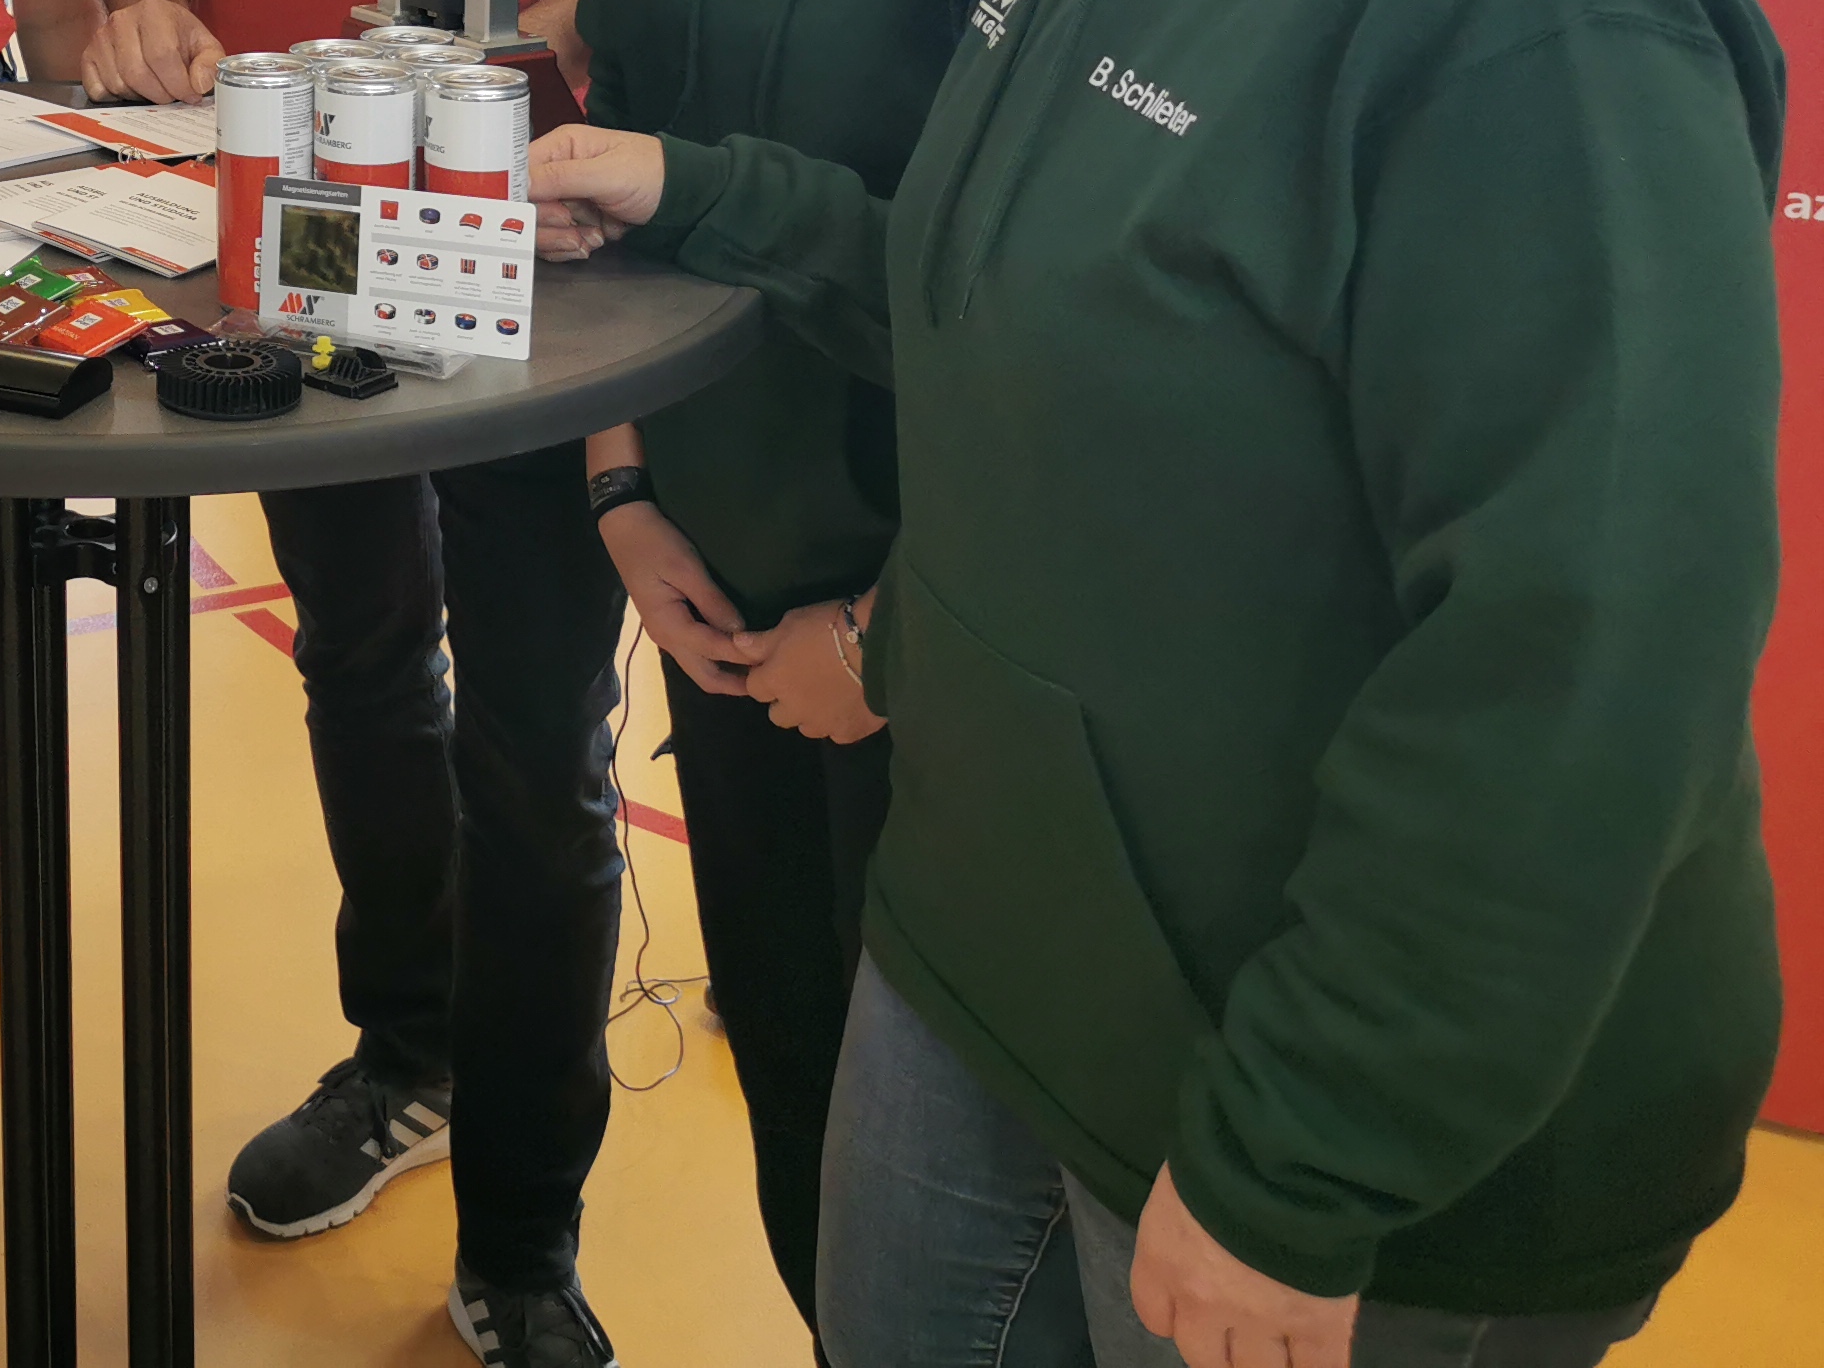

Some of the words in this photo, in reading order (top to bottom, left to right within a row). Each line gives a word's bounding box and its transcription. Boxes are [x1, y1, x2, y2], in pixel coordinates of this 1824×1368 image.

[1088, 56, 1115, 92] B.
[1111, 68, 1198, 136] Schlieter
[282, 184, 349, 199] Magnetisierungsarten
[129, 195, 151, 205] UND
[151, 203, 198, 221] STUDIUM
[136, 192, 200, 215] AUSBILDUNG
[286, 314, 335, 327] SCHRAMBERG
